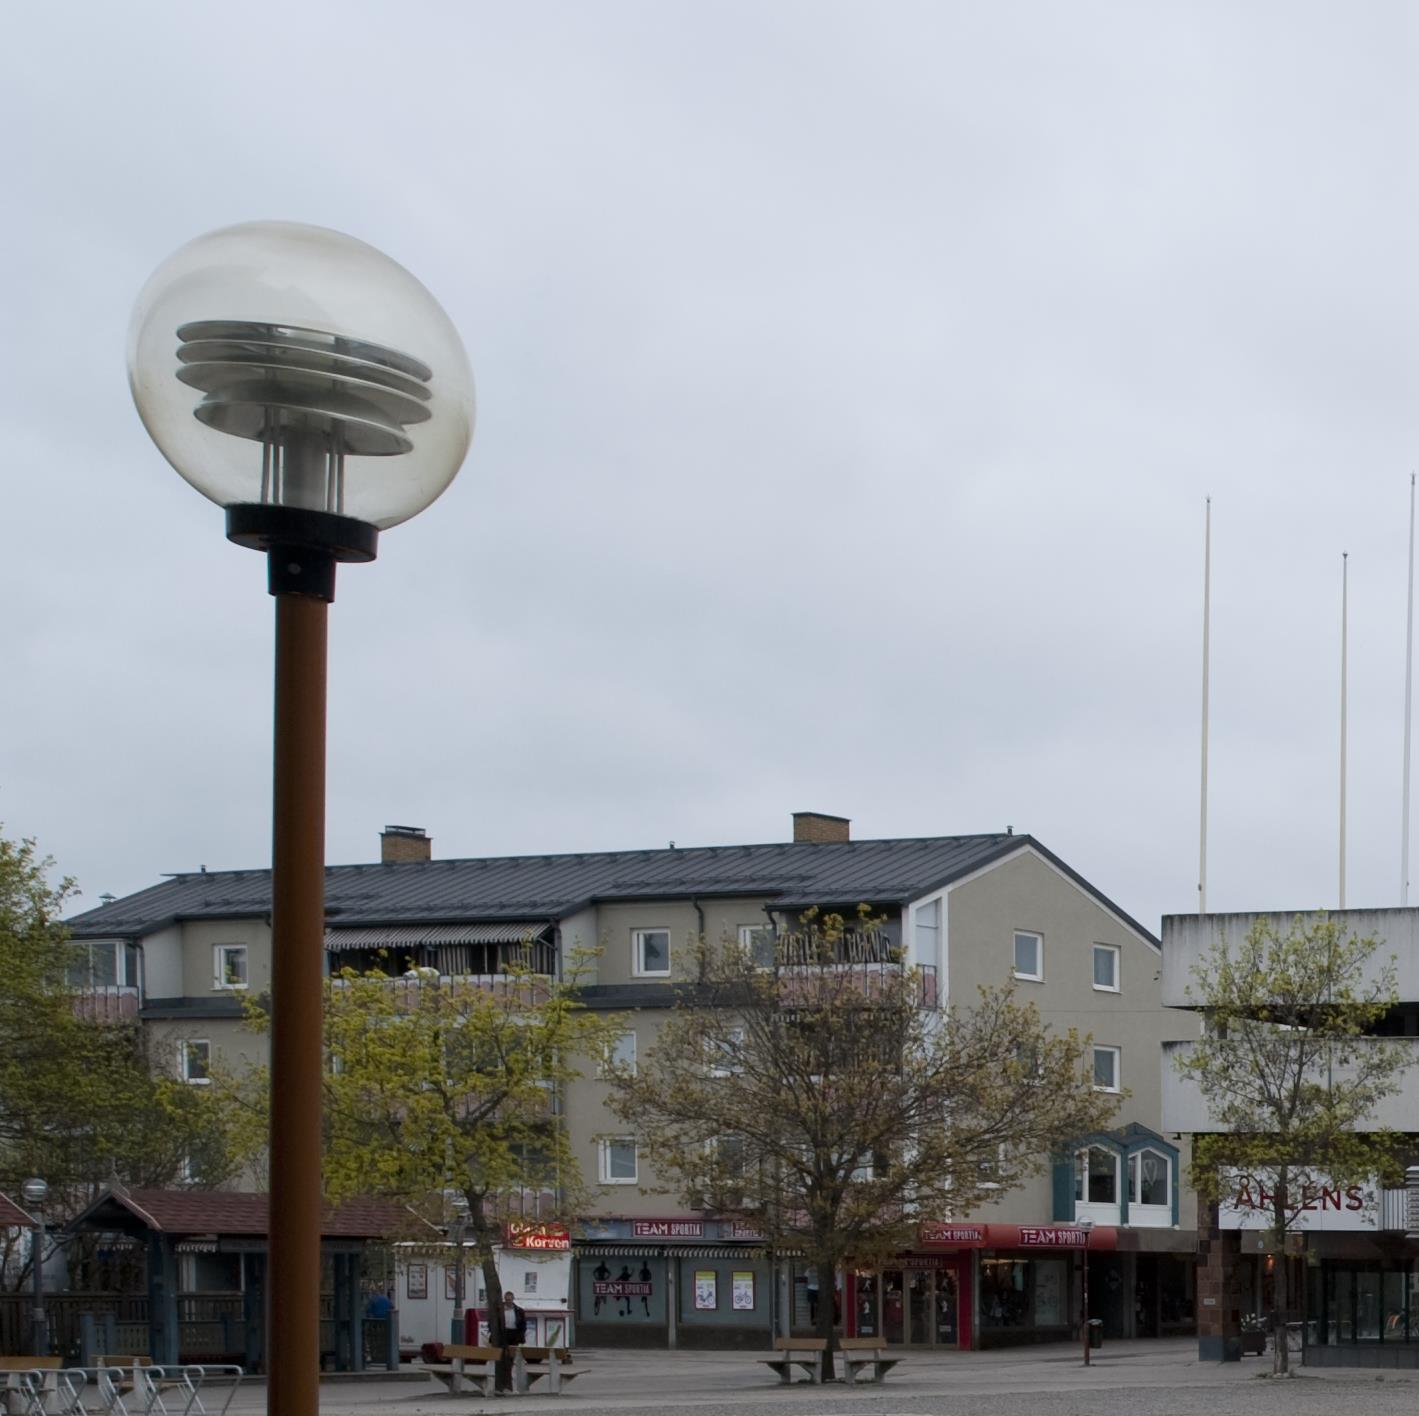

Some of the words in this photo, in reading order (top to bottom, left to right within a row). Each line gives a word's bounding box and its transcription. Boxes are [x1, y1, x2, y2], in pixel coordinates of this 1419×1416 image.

[635, 1222, 668, 1235] TEAM
[671, 1223, 700, 1235] SPORTIA
[924, 1230, 951, 1240] TEAM
[953, 1230, 982, 1240] SPORTIA
[1022, 1230, 1055, 1244] TEAM
[595, 1283, 622, 1294] TEAM
[624, 1283, 650, 1294] SPORTIA
